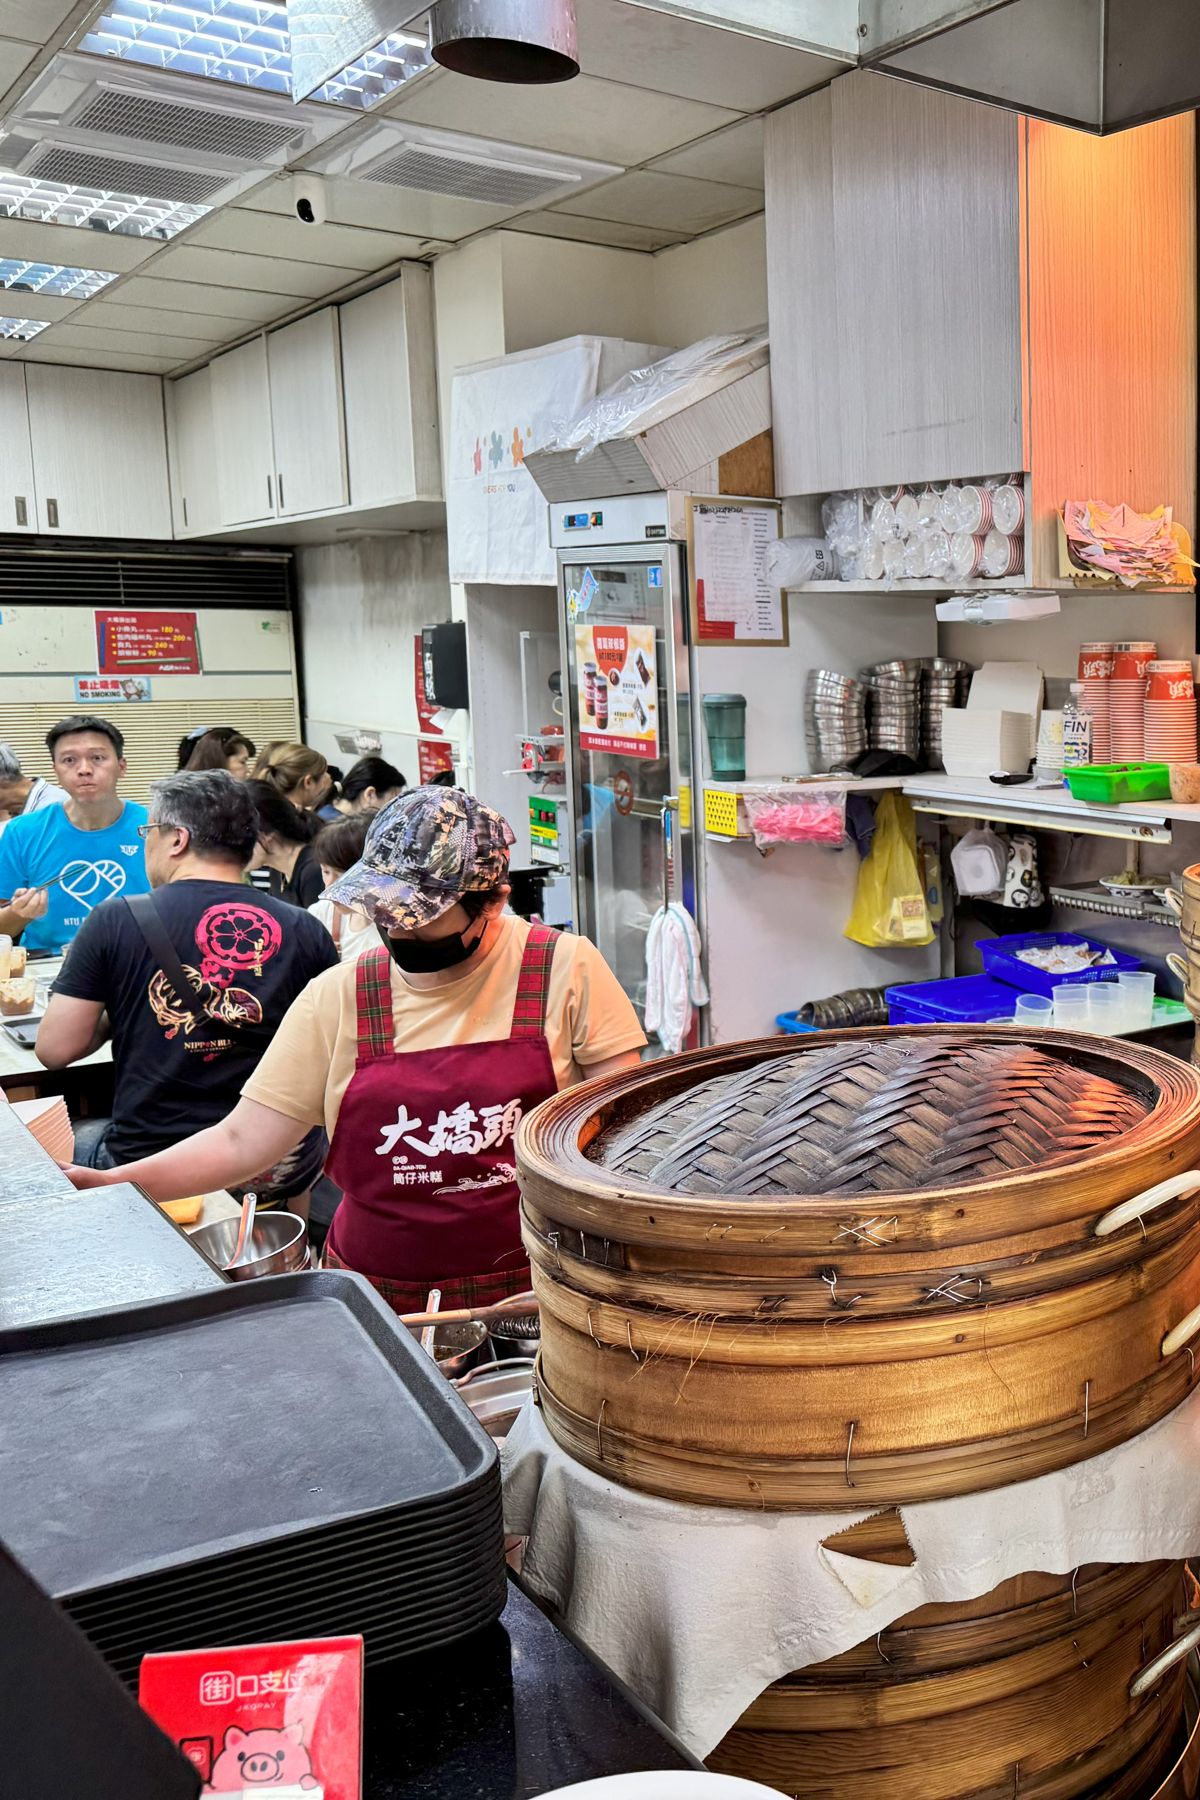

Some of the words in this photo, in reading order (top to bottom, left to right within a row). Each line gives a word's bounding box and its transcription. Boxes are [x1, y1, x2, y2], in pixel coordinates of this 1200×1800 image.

[1064, 720, 1087, 733] FIN
[64, 917, 80, 926] NTU
[375, 1098, 522, 1157] 大橋頭
[393, 1170, 443, 1186] 筒仔米糕
[200, 1668, 306, 1706] 街口支付
